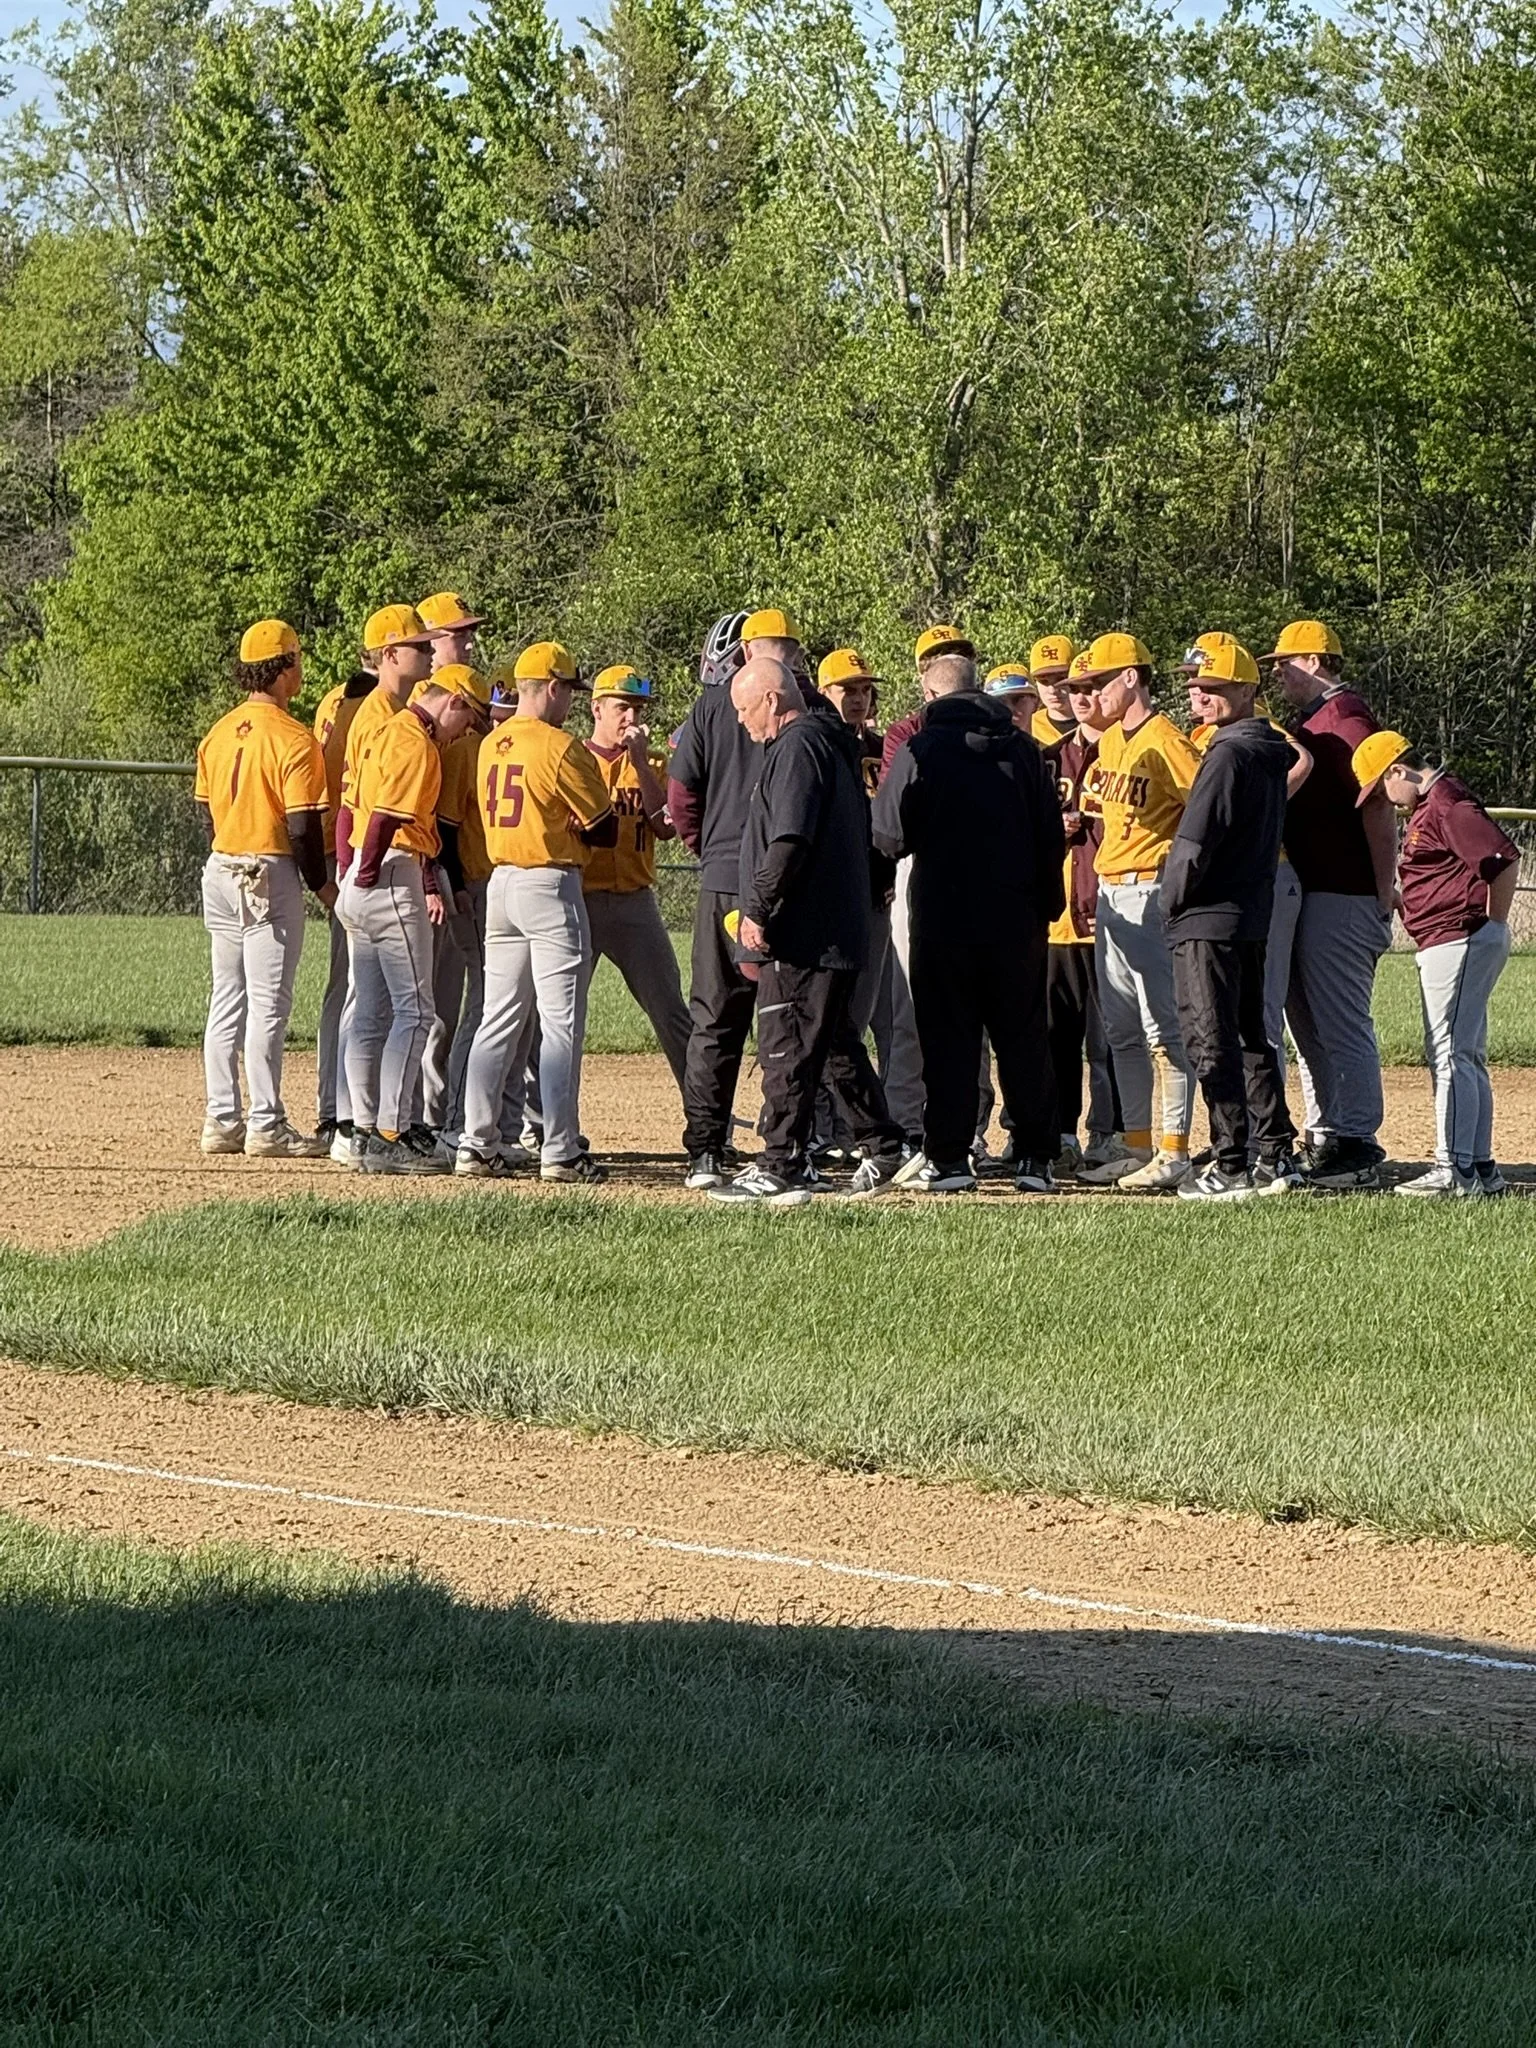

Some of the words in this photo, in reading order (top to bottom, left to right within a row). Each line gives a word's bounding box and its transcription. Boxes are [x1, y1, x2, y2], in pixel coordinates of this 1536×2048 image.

[1041, 645, 1058, 660] SE
[231, 747, 244, 806] 1
[486, 764, 525, 828] 45
[1120, 812, 1136, 841] 3
